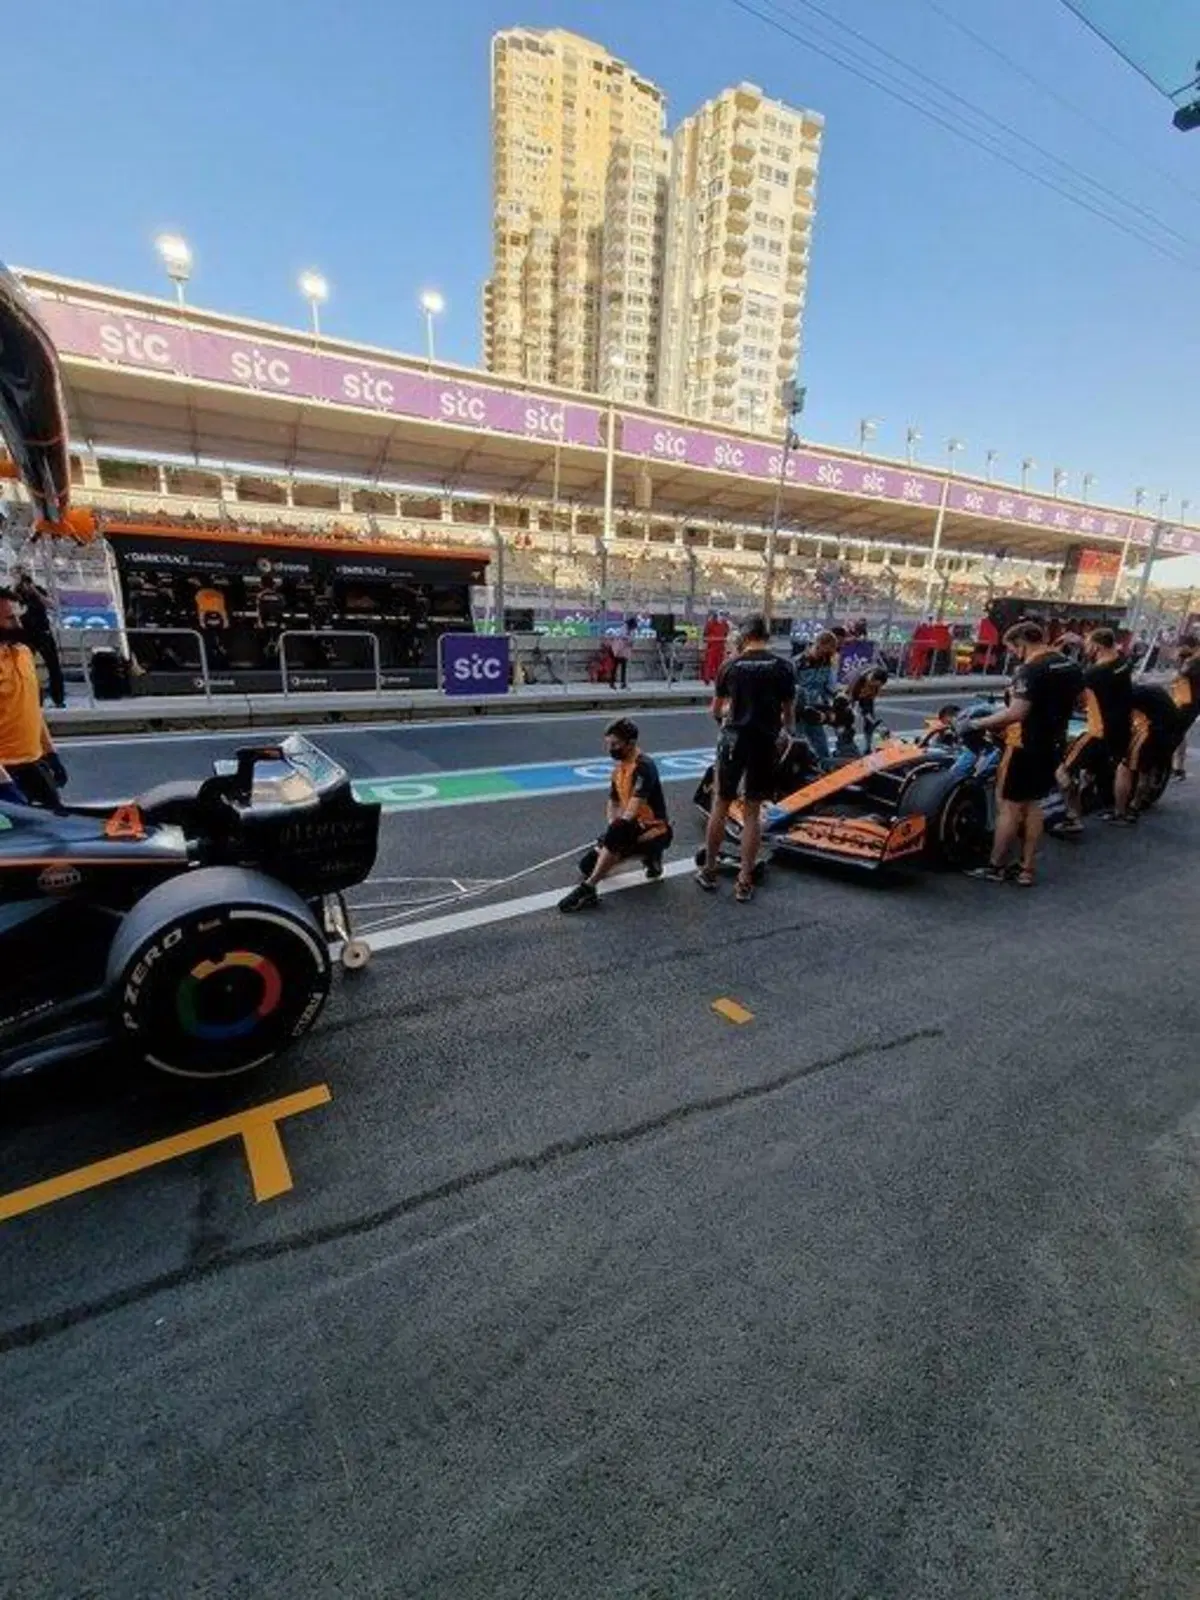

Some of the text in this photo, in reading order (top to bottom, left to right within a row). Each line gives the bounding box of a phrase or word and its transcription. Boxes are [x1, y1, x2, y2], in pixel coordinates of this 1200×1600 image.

[100, 322, 170, 364] stc
[231, 350, 291, 385] stc
[343, 371, 395, 405] stc
[439, 390, 486, 420] stc
[524, 406, 564, 434] stc
[653, 431, 687, 457] stc
[714, 443, 745, 467] stc
[453, 653, 501, 680] stc
[124, 928, 182, 1005] ZERO
